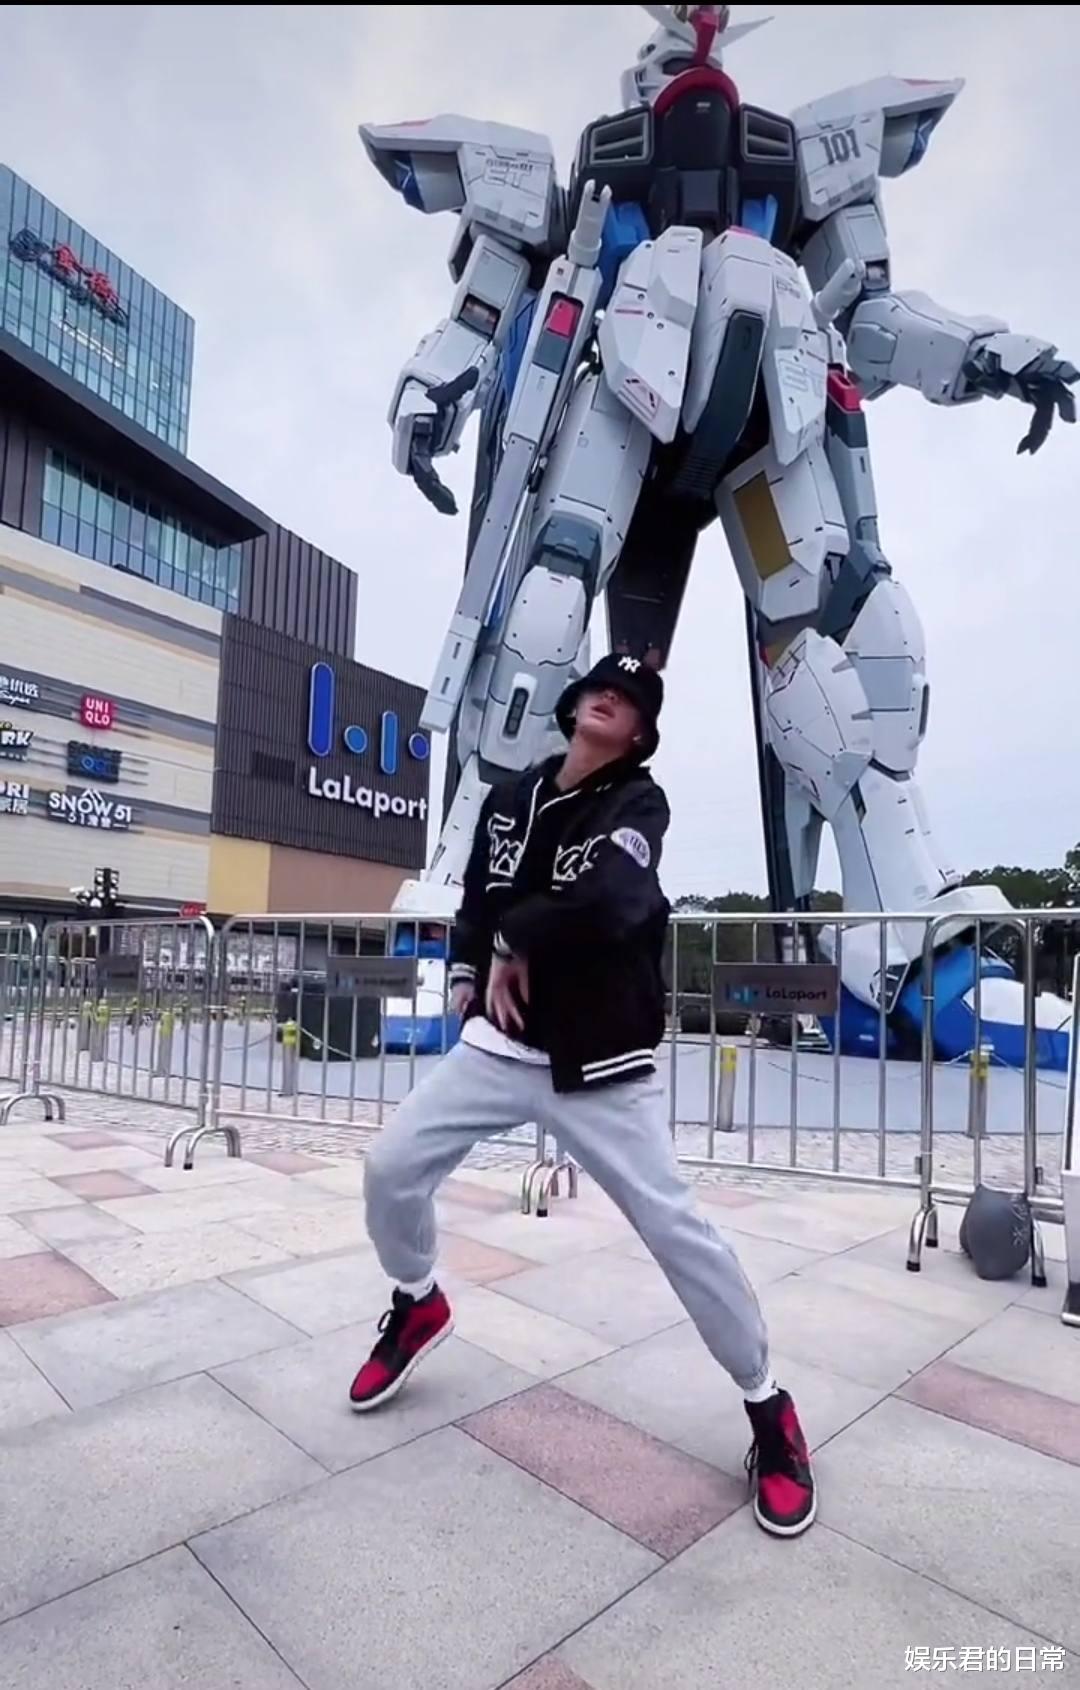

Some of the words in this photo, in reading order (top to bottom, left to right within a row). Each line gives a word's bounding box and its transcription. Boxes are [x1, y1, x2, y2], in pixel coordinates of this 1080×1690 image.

[818, 128, 861, 165] 101
[86, 697, 109, 713] UNI
[85, 710, 110, 726] QLO
[308, 766, 427, 821] LaLaport
[766, 985, 828, 1001] LaLaport
